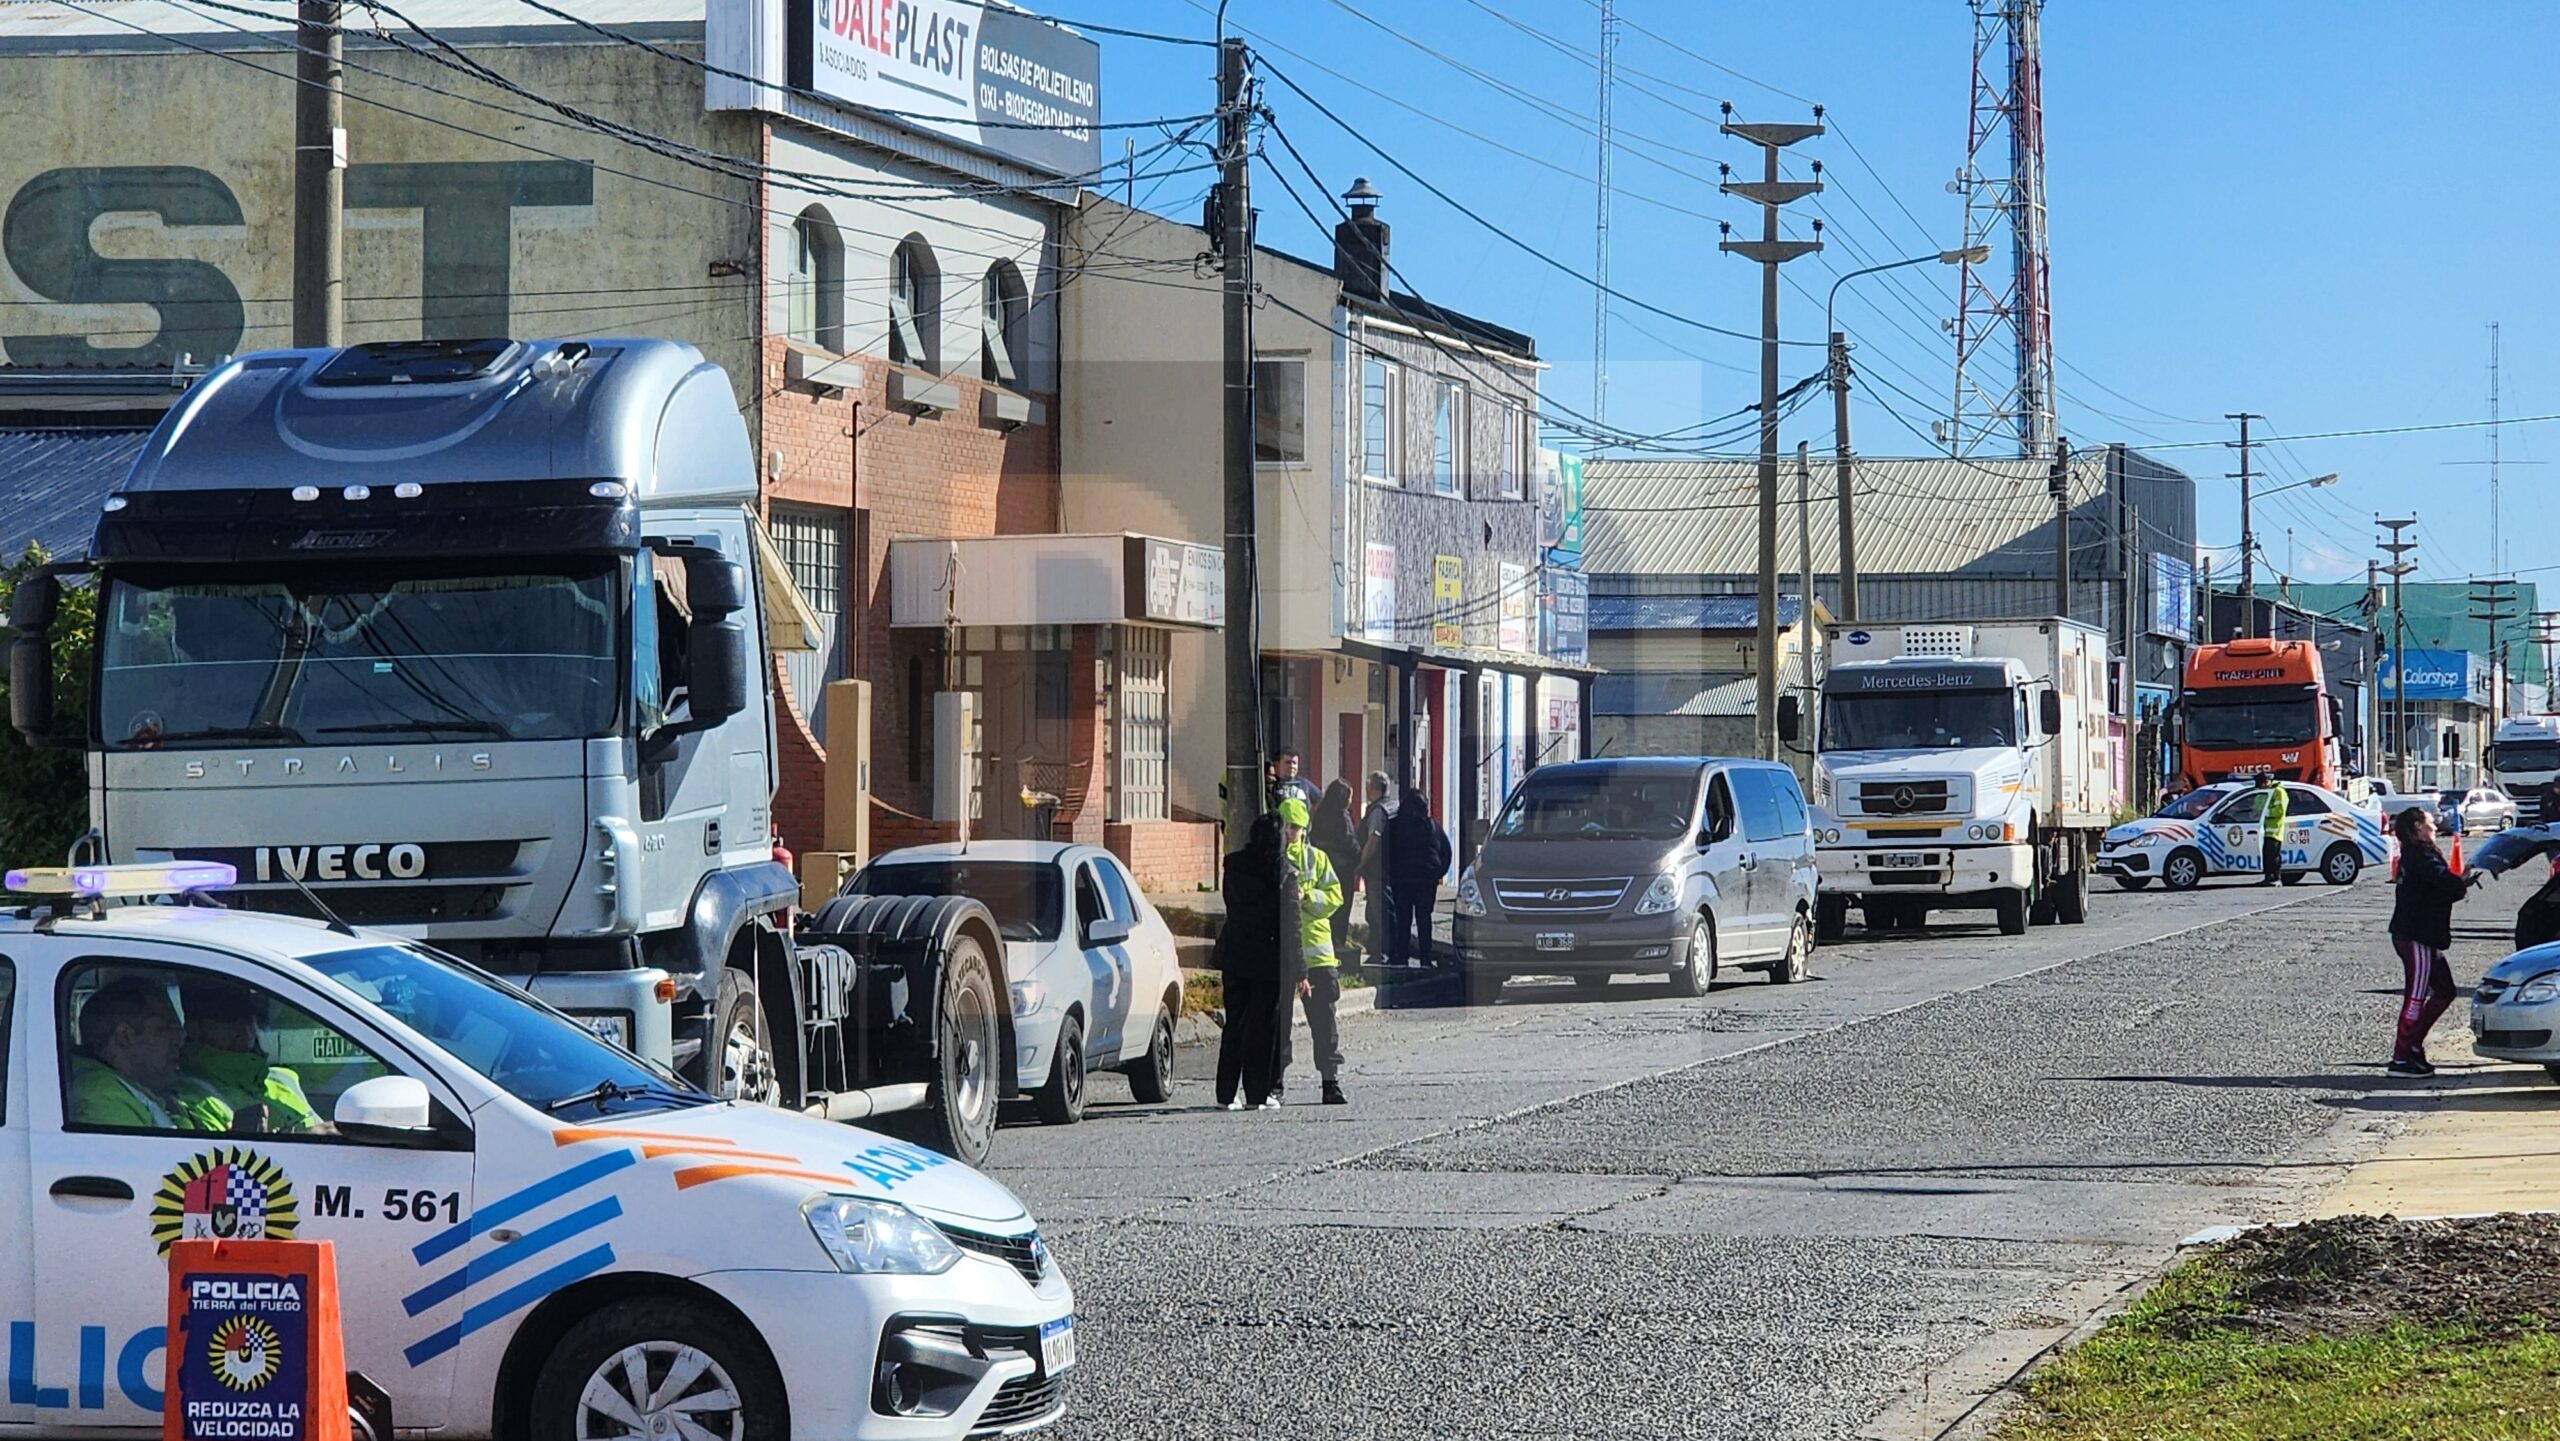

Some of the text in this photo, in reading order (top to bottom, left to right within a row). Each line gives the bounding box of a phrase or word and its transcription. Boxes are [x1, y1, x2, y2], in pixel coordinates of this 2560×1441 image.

[825, 45, 868, 82] ASOCIADOS
[980, 44, 1093, 107] BOLSAS DE POLIETILENO
[980, 83, 998, 112] OXI
[1004, 91, 1090, 142] BIODEGRADABLES
[1862, 673, 1974, 689] Mercedes-Benz
[186, 753, 492, 779] STRALIS
[255, 843, 426, 881] IVECO
[314, 1184, 460, 1224] M. 561
[192, 1280, 300, 1301] POLICIA
[192, 1299, 301, 1312] TIERRA del FUEGO
[188, 1401, 300, 1419] REDUZCA LA
[192, 1420, 295, 1438] VELOCIDAD
